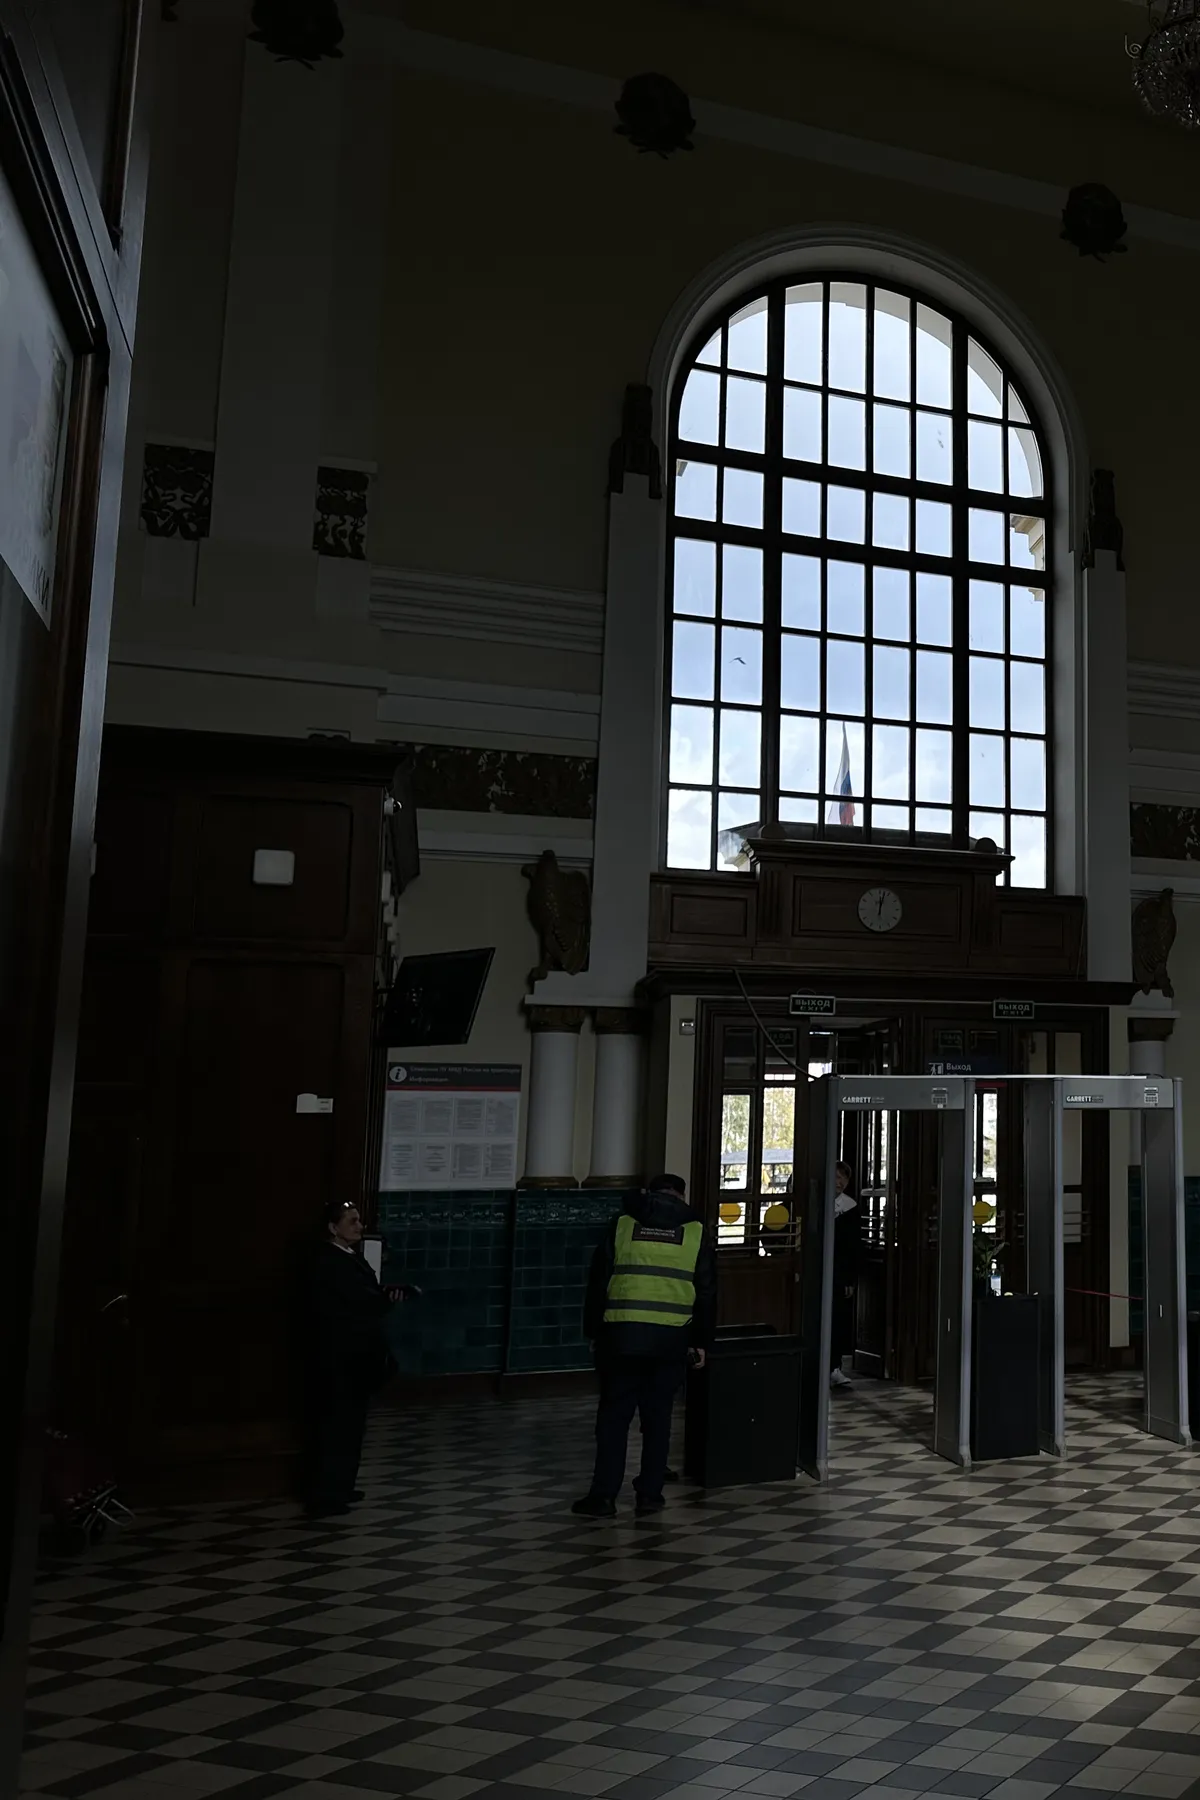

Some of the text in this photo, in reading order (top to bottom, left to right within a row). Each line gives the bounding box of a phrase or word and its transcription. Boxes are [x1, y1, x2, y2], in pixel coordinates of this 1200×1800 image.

[795, 999, 831, 1008] ВЫХОД
[998, 1003, 1030, 1011] ВЫХОД
[946, 1062, 972, 1072] Выход
[842, 1096, 872, 1104] GARRETT
